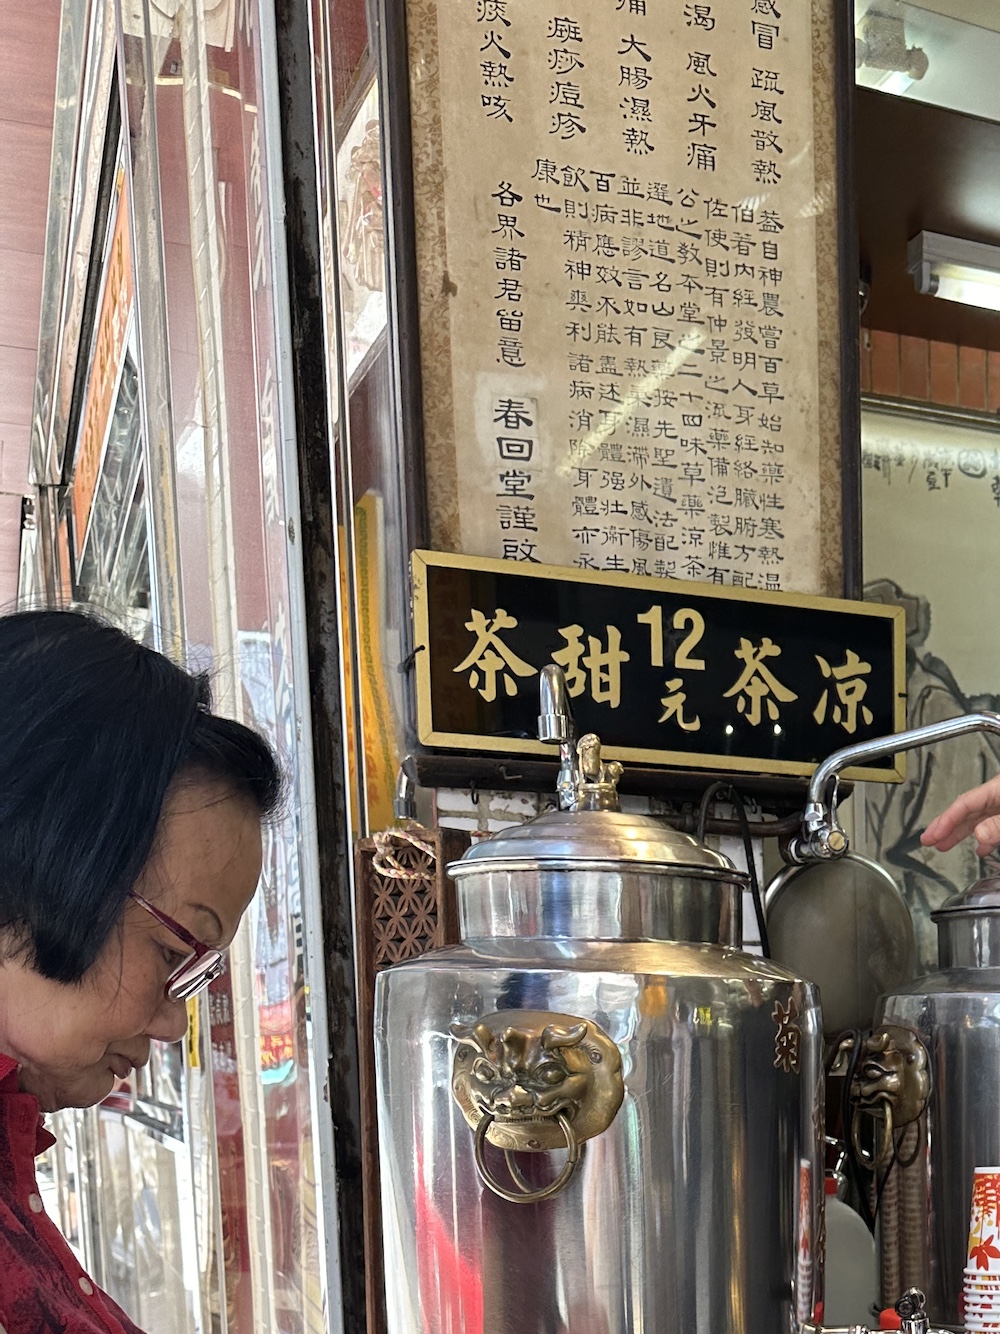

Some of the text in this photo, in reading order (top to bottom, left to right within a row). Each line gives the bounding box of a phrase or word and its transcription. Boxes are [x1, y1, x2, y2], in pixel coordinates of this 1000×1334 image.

[686, 51, 717, 171] 風火牙痛
[637, 605, 705, 671] 12
[658, 678, 700, 732] 元
